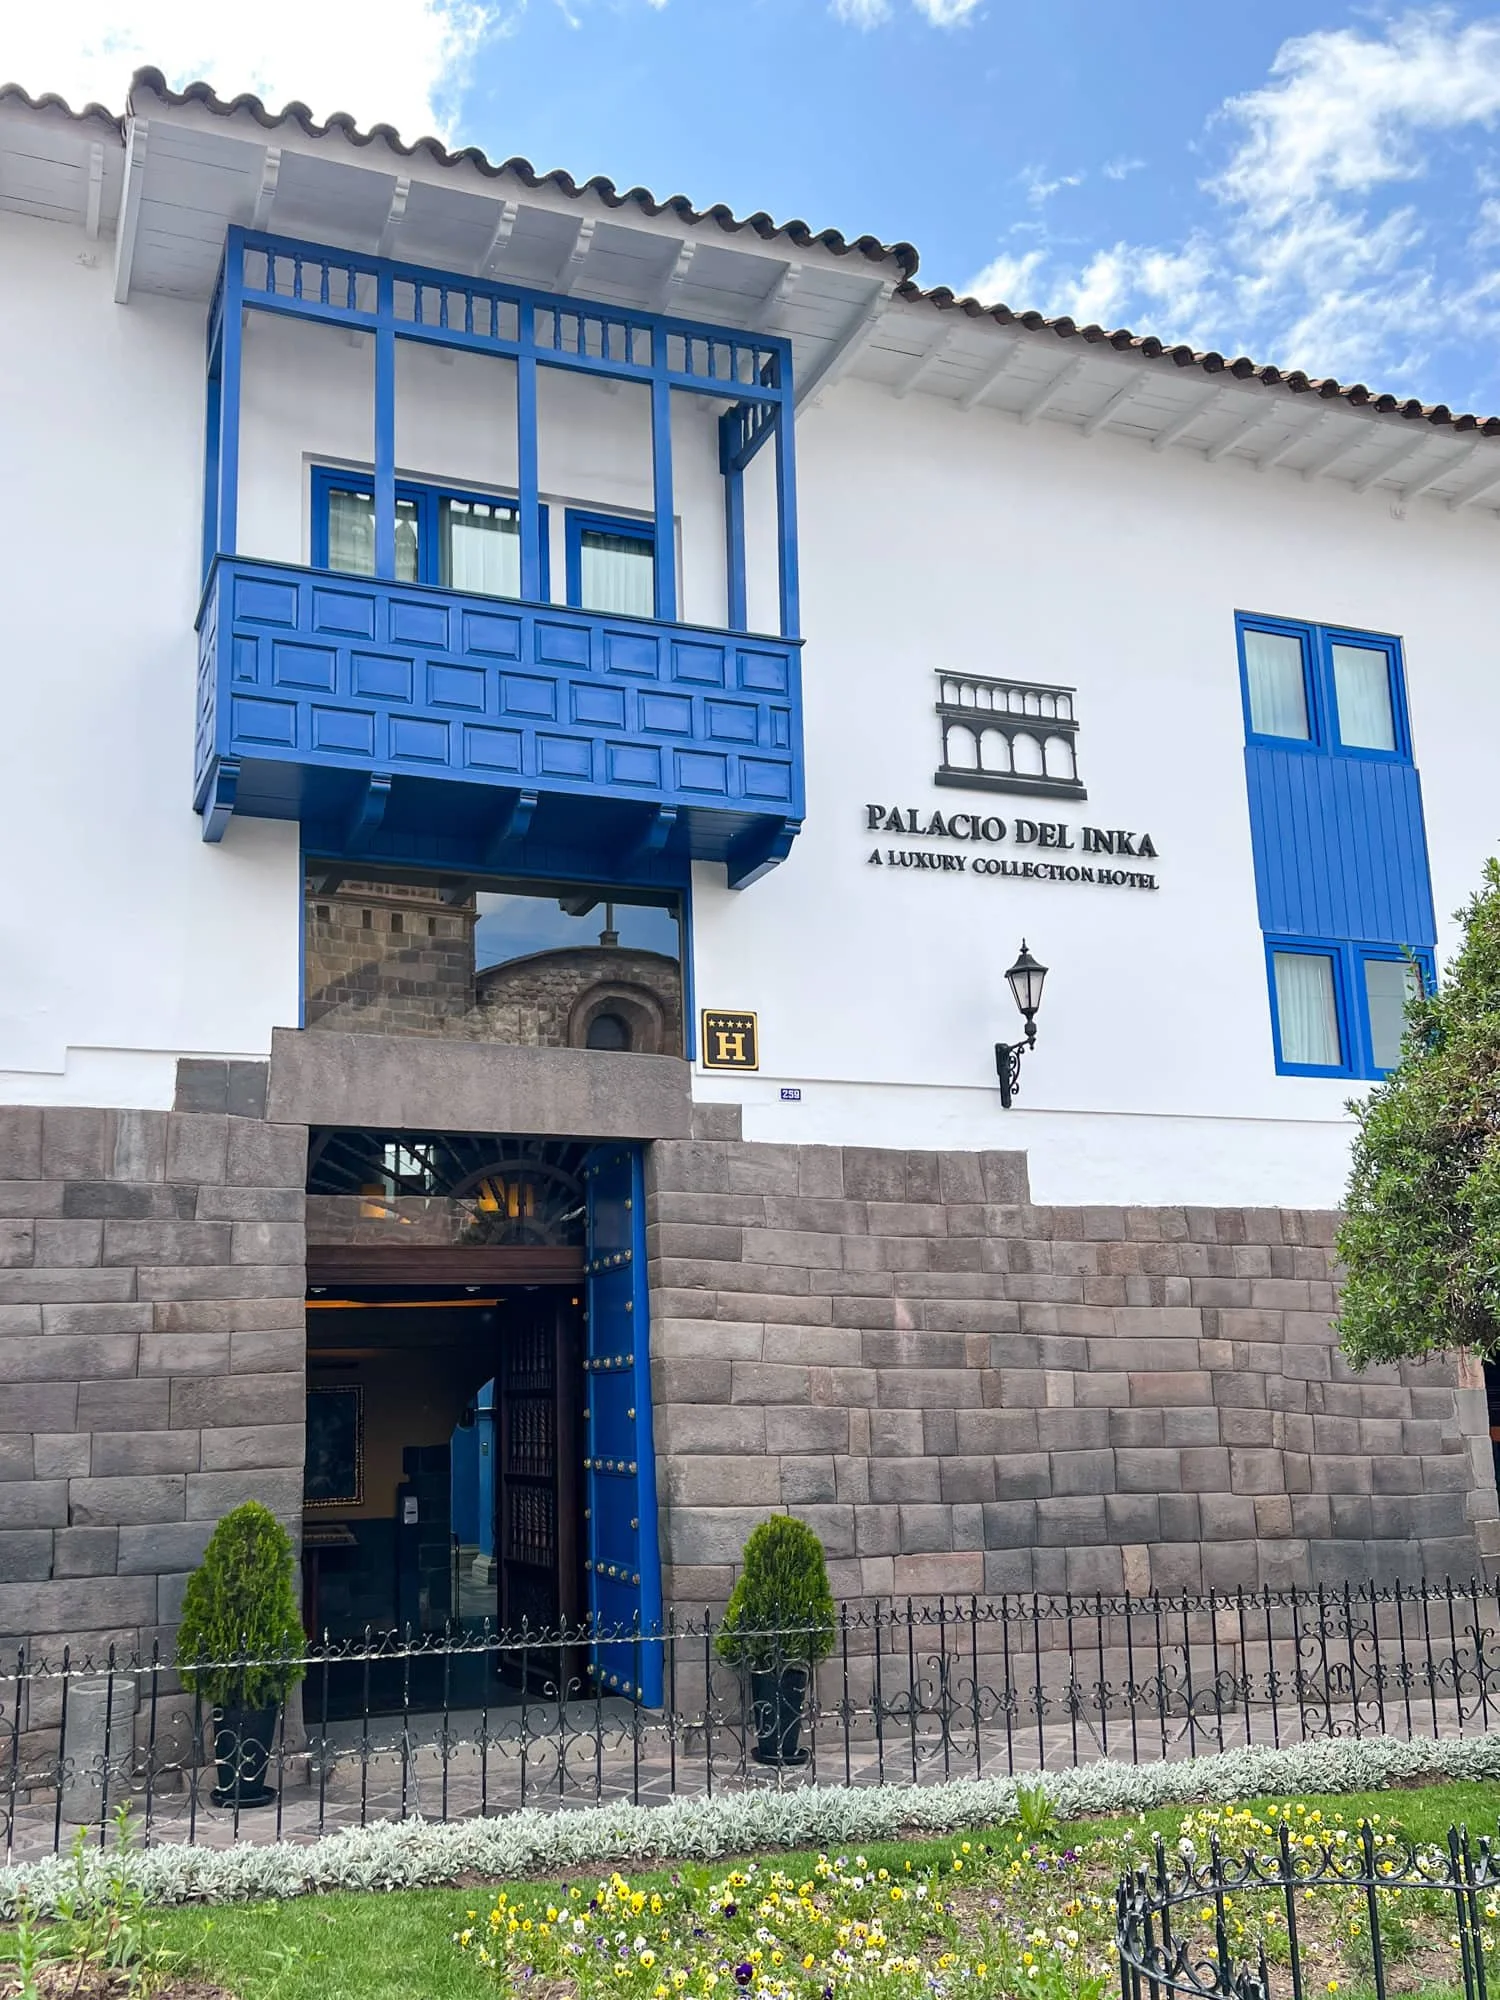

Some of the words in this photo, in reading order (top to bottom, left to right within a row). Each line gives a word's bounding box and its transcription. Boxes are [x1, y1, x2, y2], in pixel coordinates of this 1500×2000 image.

[865, 804, 1007, 842] PALACIO
[1014, 819, 1075, 849] DEL
[1081, 827, 1160, 858] INKA
[868, 849, 884, 865] A
[888, 850, 967, 873] LUXURY
[972, 858, 1095, 883] COLLECTION
[1098, 869, 1160, 890] HOTEL
[715, 1031, 746, 1061] H
[782, 1089, 800, 1099] 259
